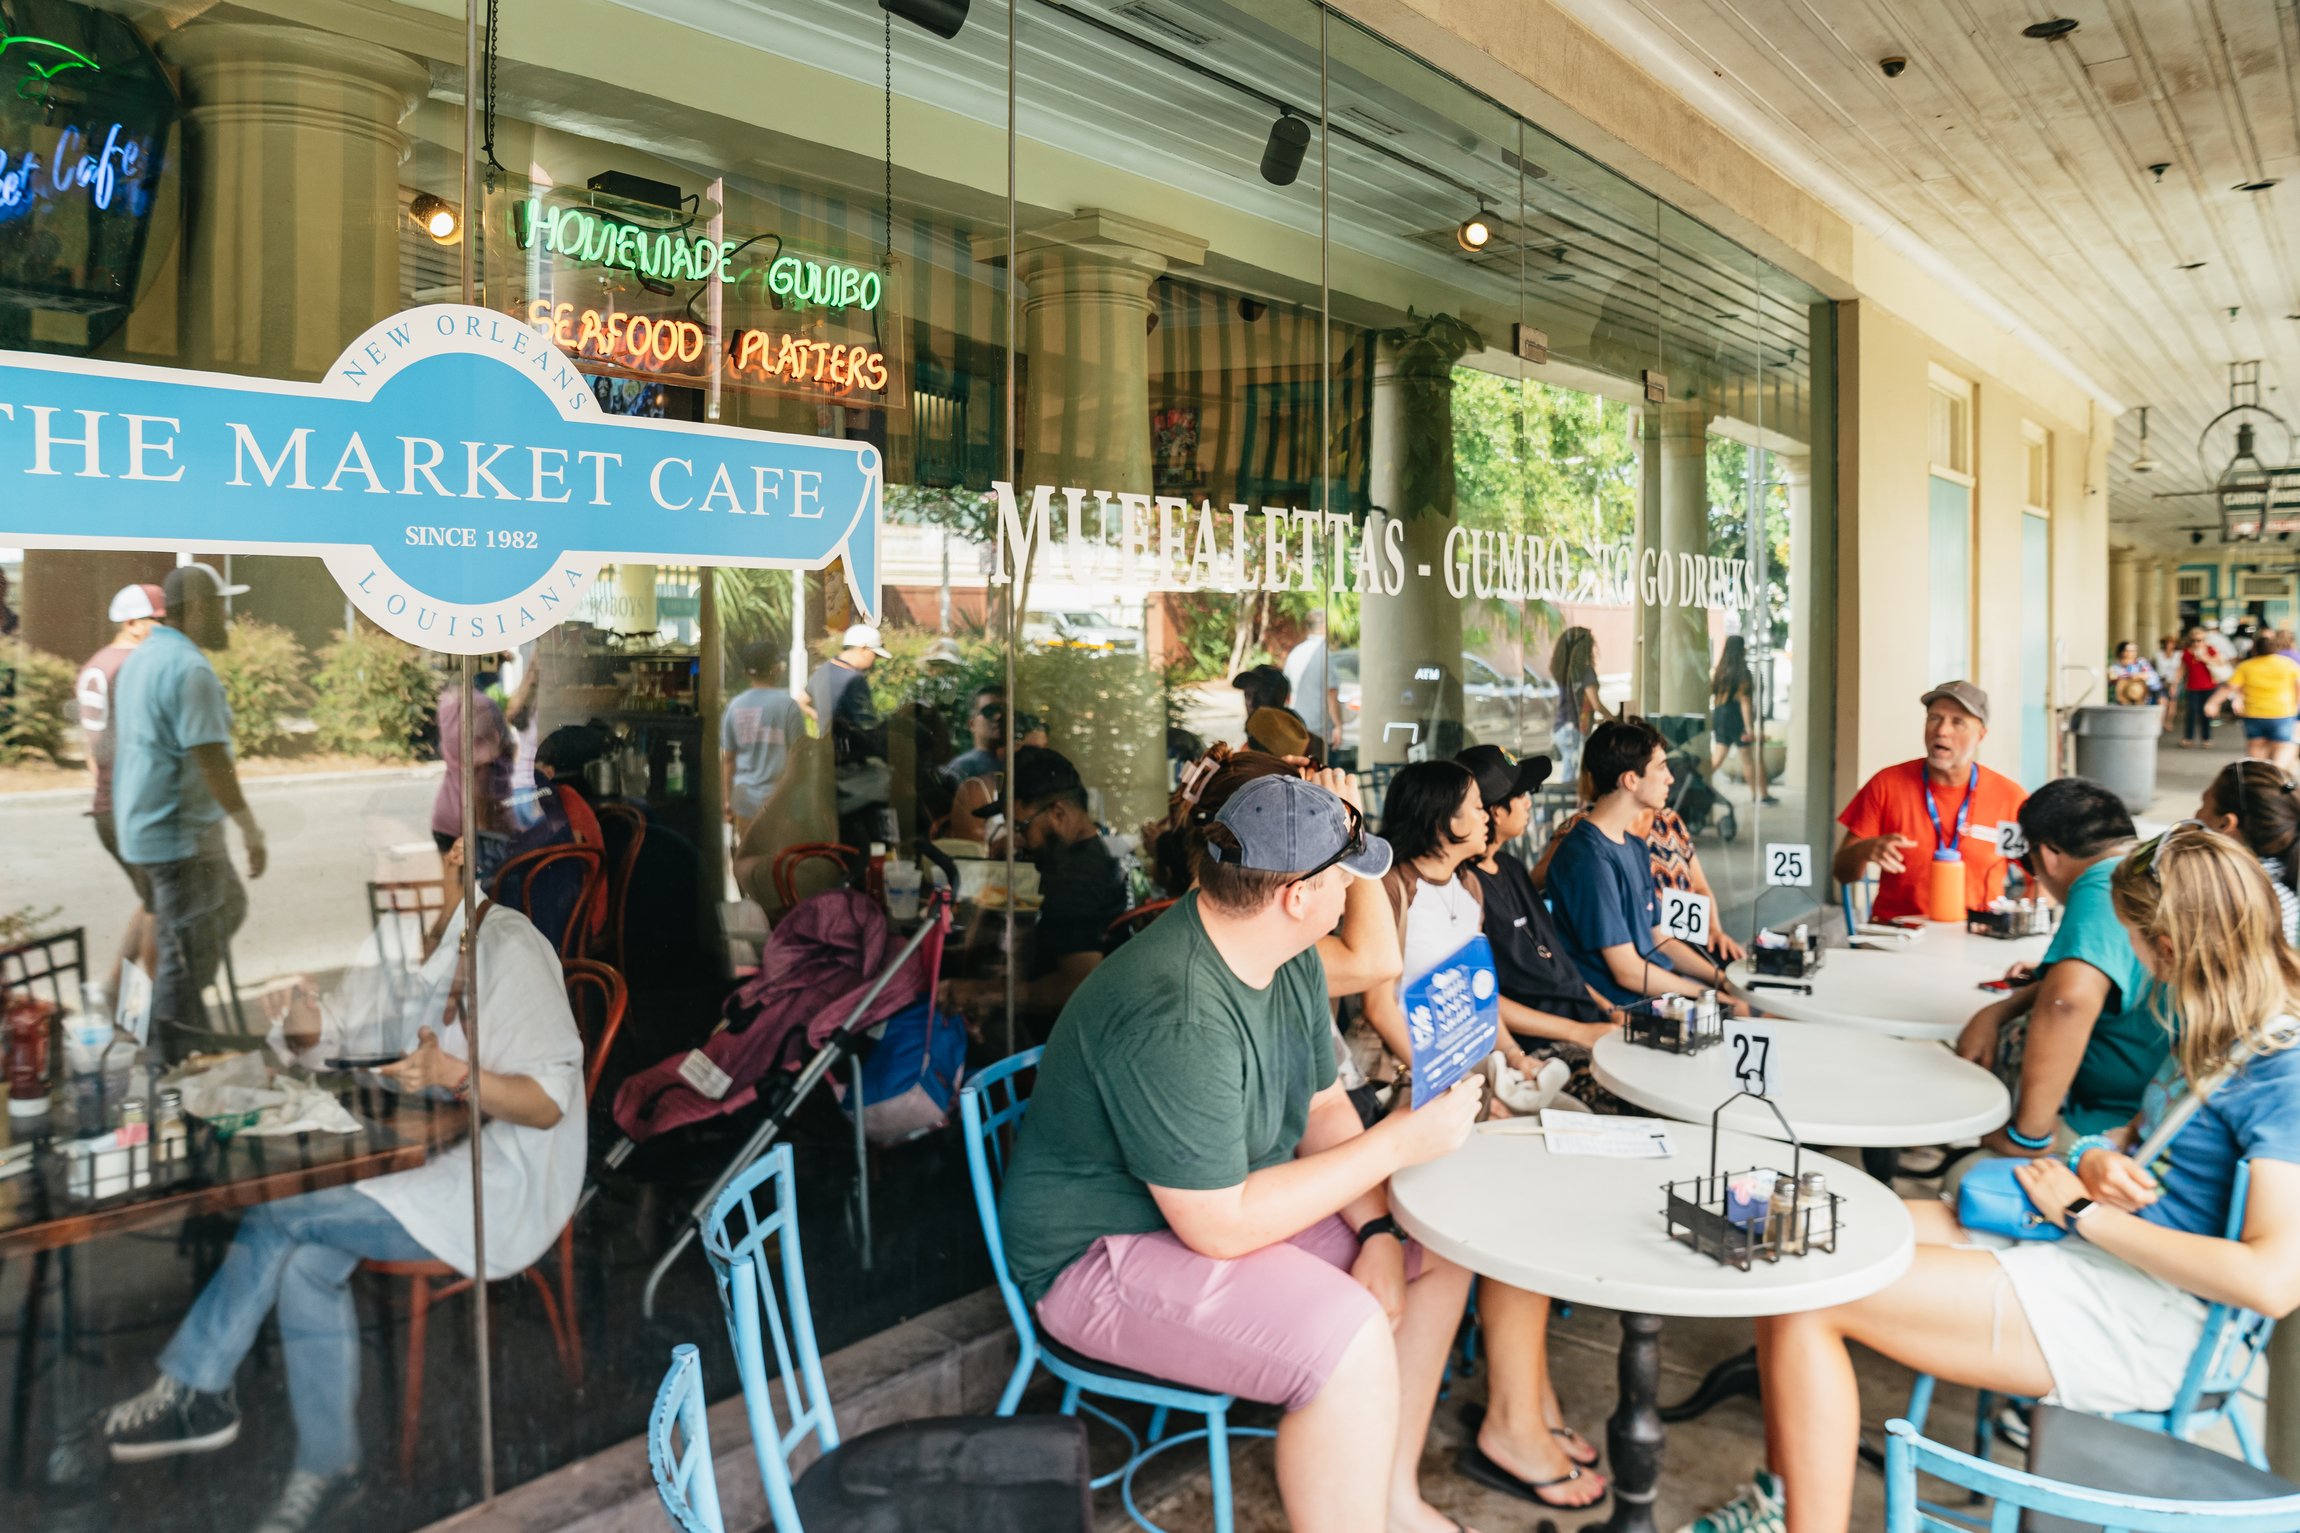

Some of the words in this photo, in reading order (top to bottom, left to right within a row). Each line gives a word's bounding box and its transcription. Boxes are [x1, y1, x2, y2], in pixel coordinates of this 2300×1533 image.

[52, 122, 140, 210] Cafe
[525, 198, 737, 285] HOMEMADE
[768, 256, 882, 312] GUMBO
[343, 322, 411, 388] NEW
[436, 314, 588, 411] ORLEANS
[529, 299, 704, 363] SEAFOOD
[738, 328, 888, 391] PLATTERS
[225, 422, 622, 506] MARKET
[649, 456, 825, 521] CAFE
[405, 525, 477, 548] SINCE
[486, 529, 539, 549] 1982
[990, 480, 1405, 597] MUFFALETTAS
[1443, 525, 1569, 601] GUMBO
[1597, 543, 1635, 603] TO
[1640, 546, 1674, 608] GO
[1679, 551, 1755, 612] DRINKS
[358, 566, 582, 638] LOUISIANA
[1414, 667, 1440, 681] ATM
[1774, 851, 1803, 878] 25
[1669, 898, 1702, 933] 26
[1733, 1033, 1769, 1082] 27
